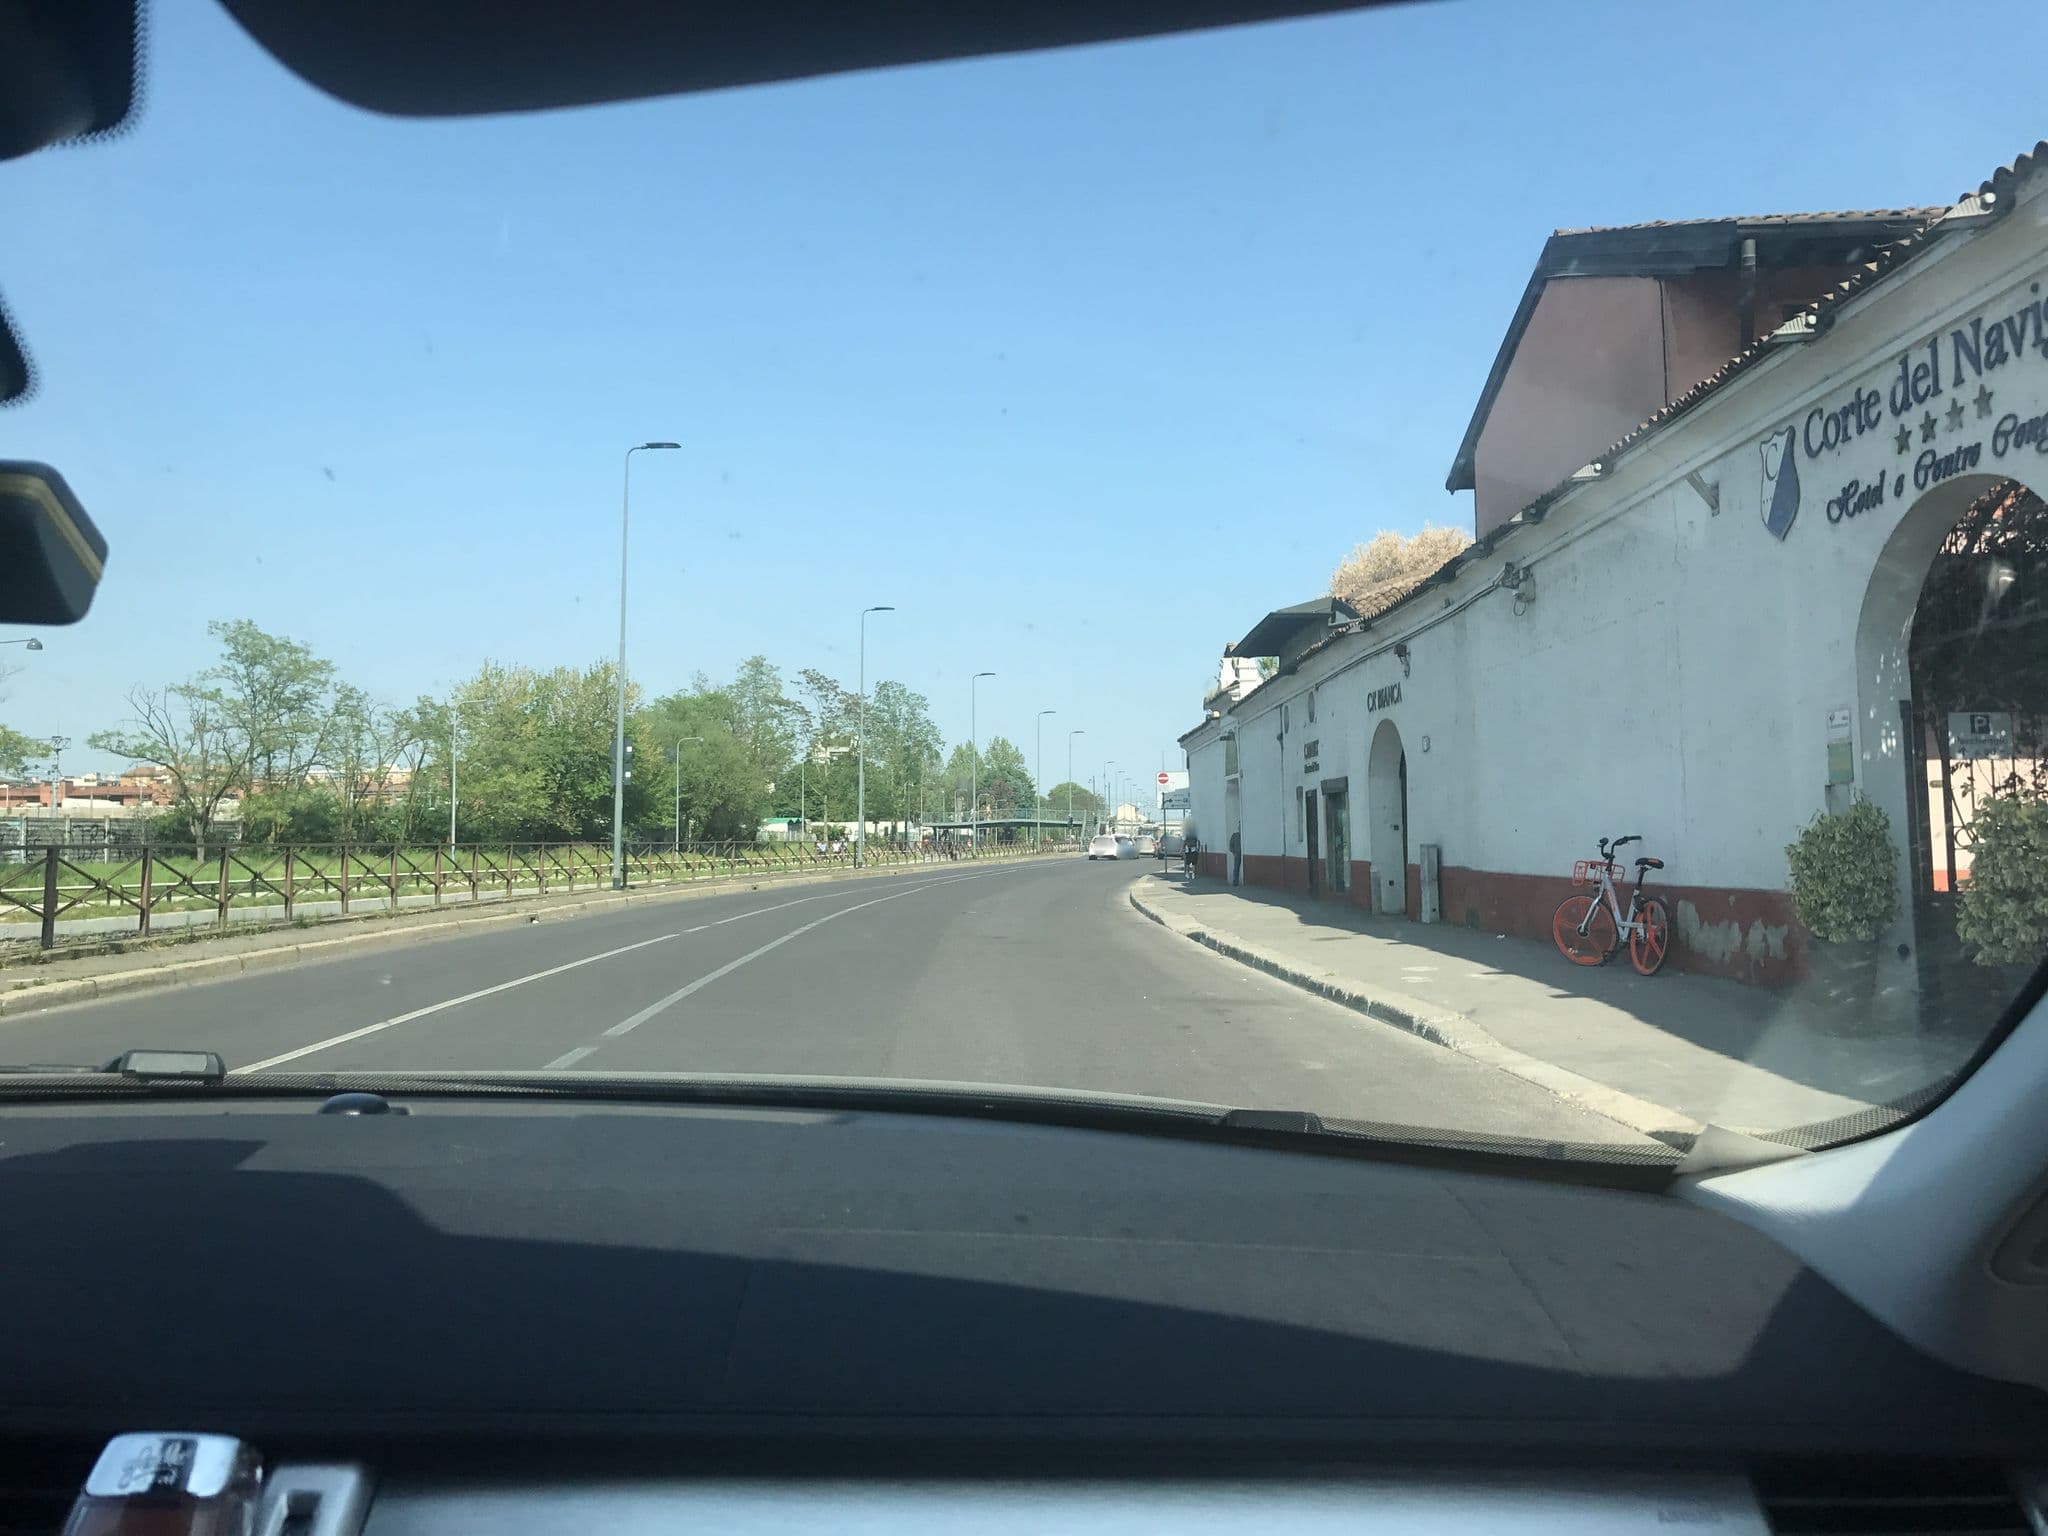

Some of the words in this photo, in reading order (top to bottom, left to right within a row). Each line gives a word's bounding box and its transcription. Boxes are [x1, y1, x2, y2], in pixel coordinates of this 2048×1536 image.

[1803, 387, 1882, 459] Corte
[1889, 336, 1943, 417] del
[1950, 281, 2048, 388] Navi
[1913, 442, 1982, 490] Centro
[1974, 716, 1988, 732] P
